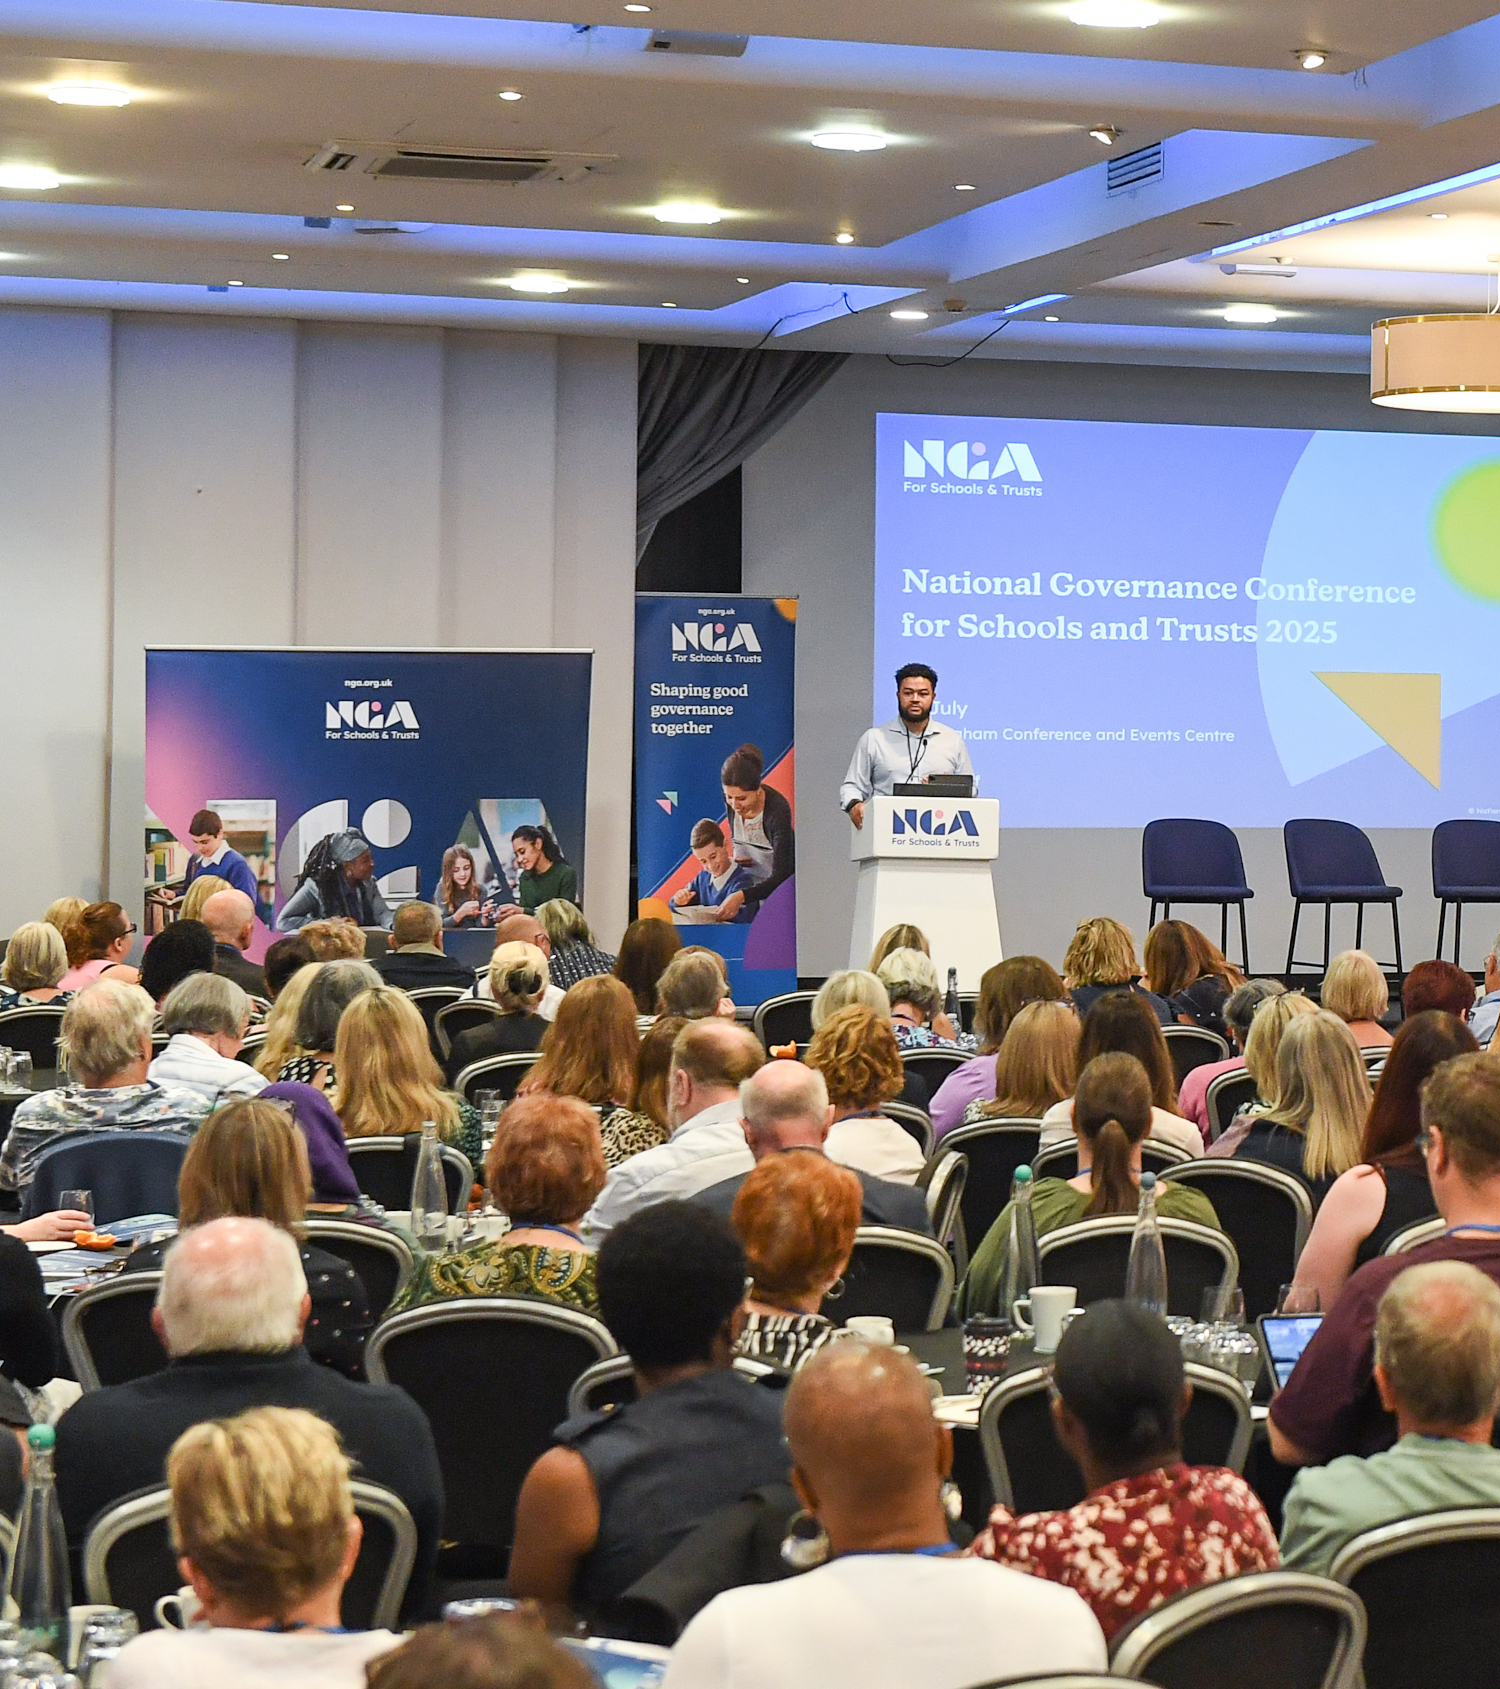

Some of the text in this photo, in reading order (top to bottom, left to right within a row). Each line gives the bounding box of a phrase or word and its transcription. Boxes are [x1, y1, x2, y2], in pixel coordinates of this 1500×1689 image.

[904, 439, 1043, 482] NGA
[903, 481, 1043, 497] For Schools & Trusts
[902, 568, 1417, 604] National Governance Conference
[698, 608, 736, 616] nga.org.uk
[901, 612, 1338, 644] for Schools and Trusts 2025
[672, 622, 762, 652] NGA
[672, 653, 762, 663] For Schools & Trusts
[344, 679, 393, 689] nga.org.uk
[650, 682, 749, 699] Shaping good
[326, 700, 420, 729] NGA
[650, 704, 734, 718] governance
[929, 700, 968, 720] July
[325, 730, 420, 739] For Schools & Trusts
[651, 721, 713, 737] together
[1002, 728, 1091, 741] Conference
[1095, 728, 1125, 741] and
[1130, 729, 1180, 742] Events
[1185, 729, 1235, 742] Centre
[892, 809, 980, 836] NGA
[908, 838, 942, 846] Schools
[954, 839, 980, 847] Trusts
